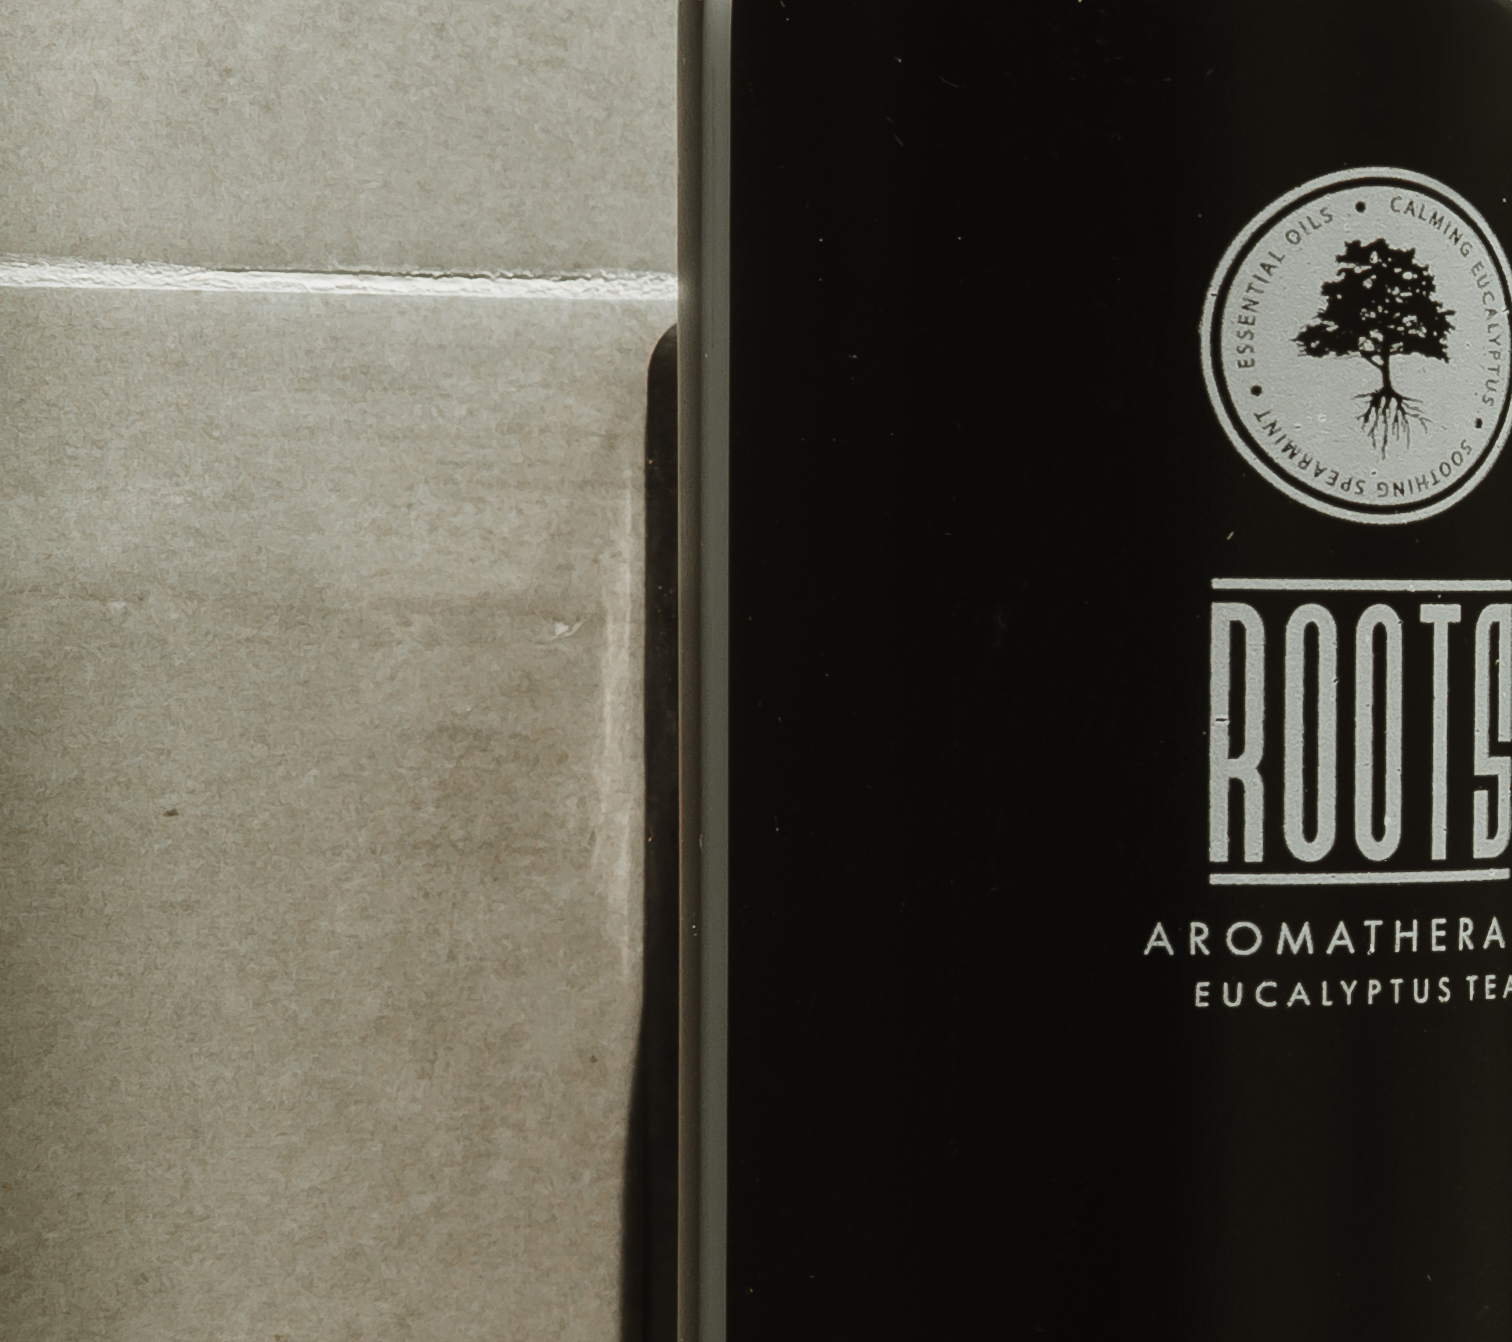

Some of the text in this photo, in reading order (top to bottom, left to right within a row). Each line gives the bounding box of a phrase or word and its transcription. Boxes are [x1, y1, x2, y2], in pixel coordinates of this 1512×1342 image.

[1237, 206, 1334, 370] ESSENTIAL OILS
[1389, 196, 1502, 408] CALMING EUCALYPTUS
[1253, 408, 1473, 497] SOOTHING SPEARMINT
[1195, 977, 1450, 1007] EUCALYPTUS
